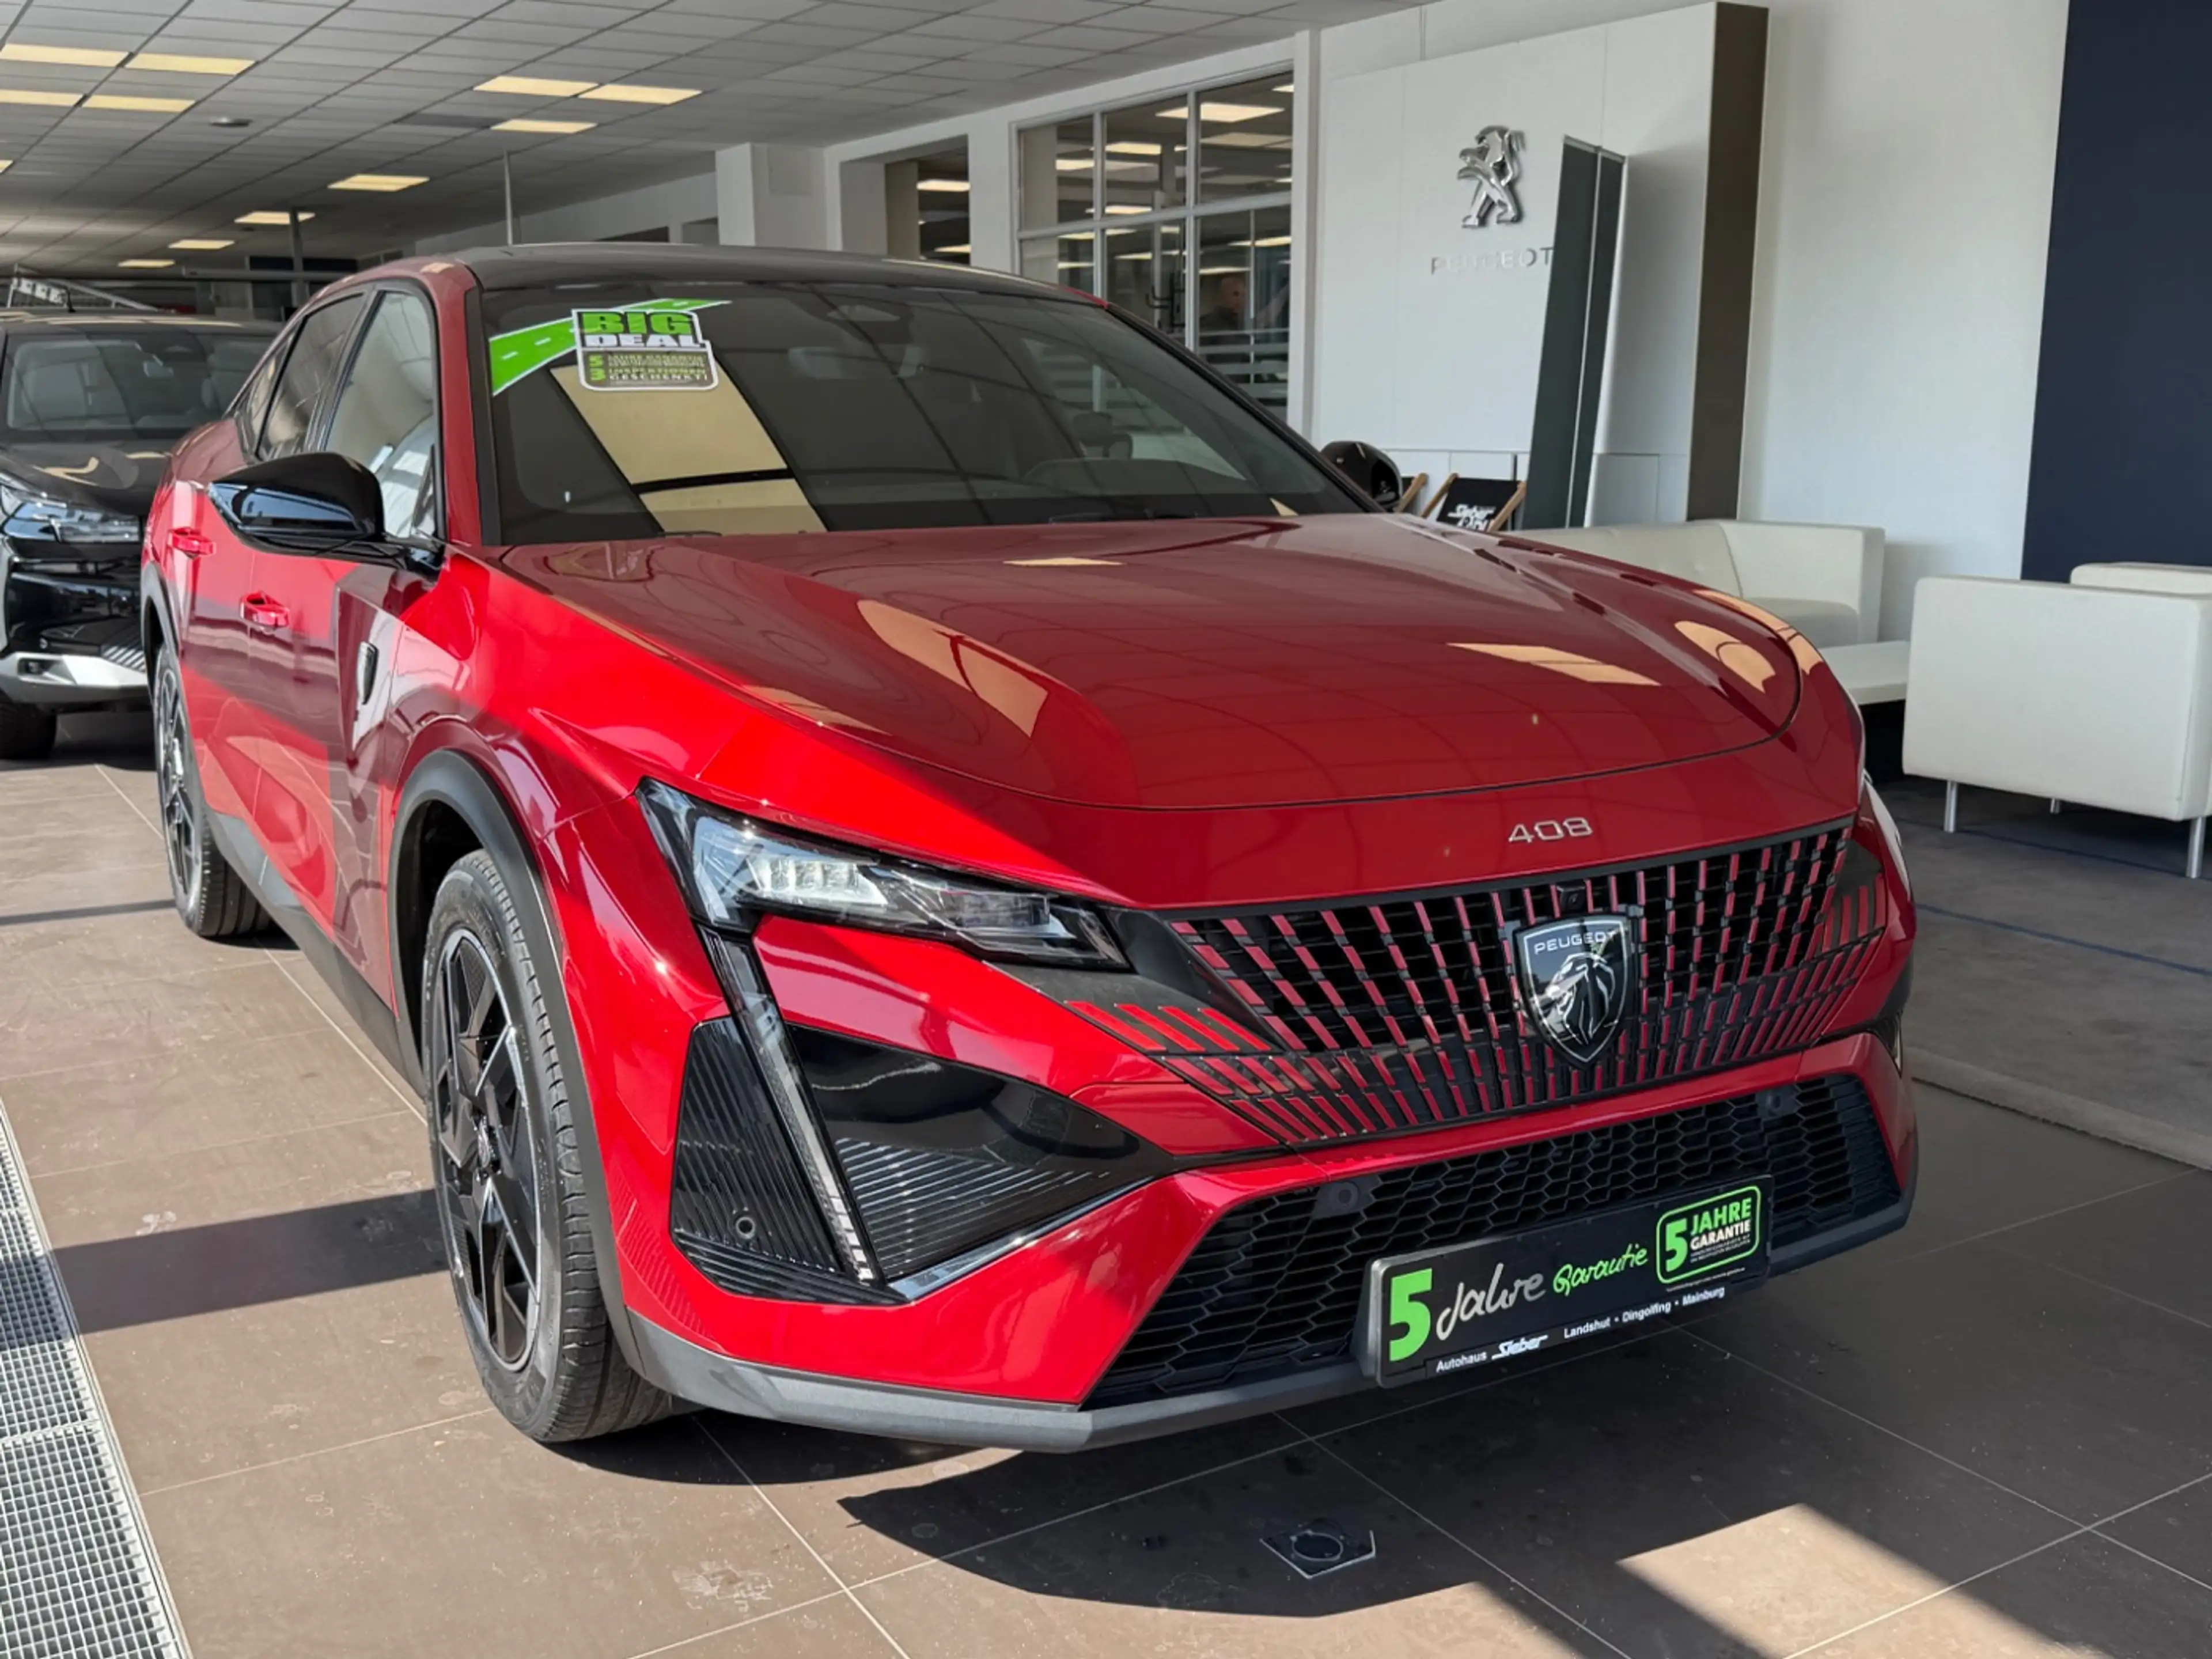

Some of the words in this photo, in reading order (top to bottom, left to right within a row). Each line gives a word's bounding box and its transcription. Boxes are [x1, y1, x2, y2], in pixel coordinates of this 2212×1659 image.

[1431, 247, 1555, 275] PEUGEOT
[582, 312, 692, 334] BIG
[584, 334, 701, 347] DEAL
[1508, 817, 1593, 843] 408
[1534, 929, 1617, 955] PEUGEOT
[1665, 1218, 1688, 1272] 5
[1690, 1197, 1752, 1236] JAHRE
[1690, 1219, 1752, 1251] GARANTIE
[1389, 1268, 1433, 1362] 5
[1435, 1262, 1546, 1341] Jahre
[1552, 1243, 1648, 1296] Garantie
[1435, 1351, 1487, 1373] Autohaus
[1564, 1316, 1611, 1339] Landshut
[1622, 1300, 1671, 1323] Dingolfing
[1682, 1286, 1725, 1306] Mainburg
